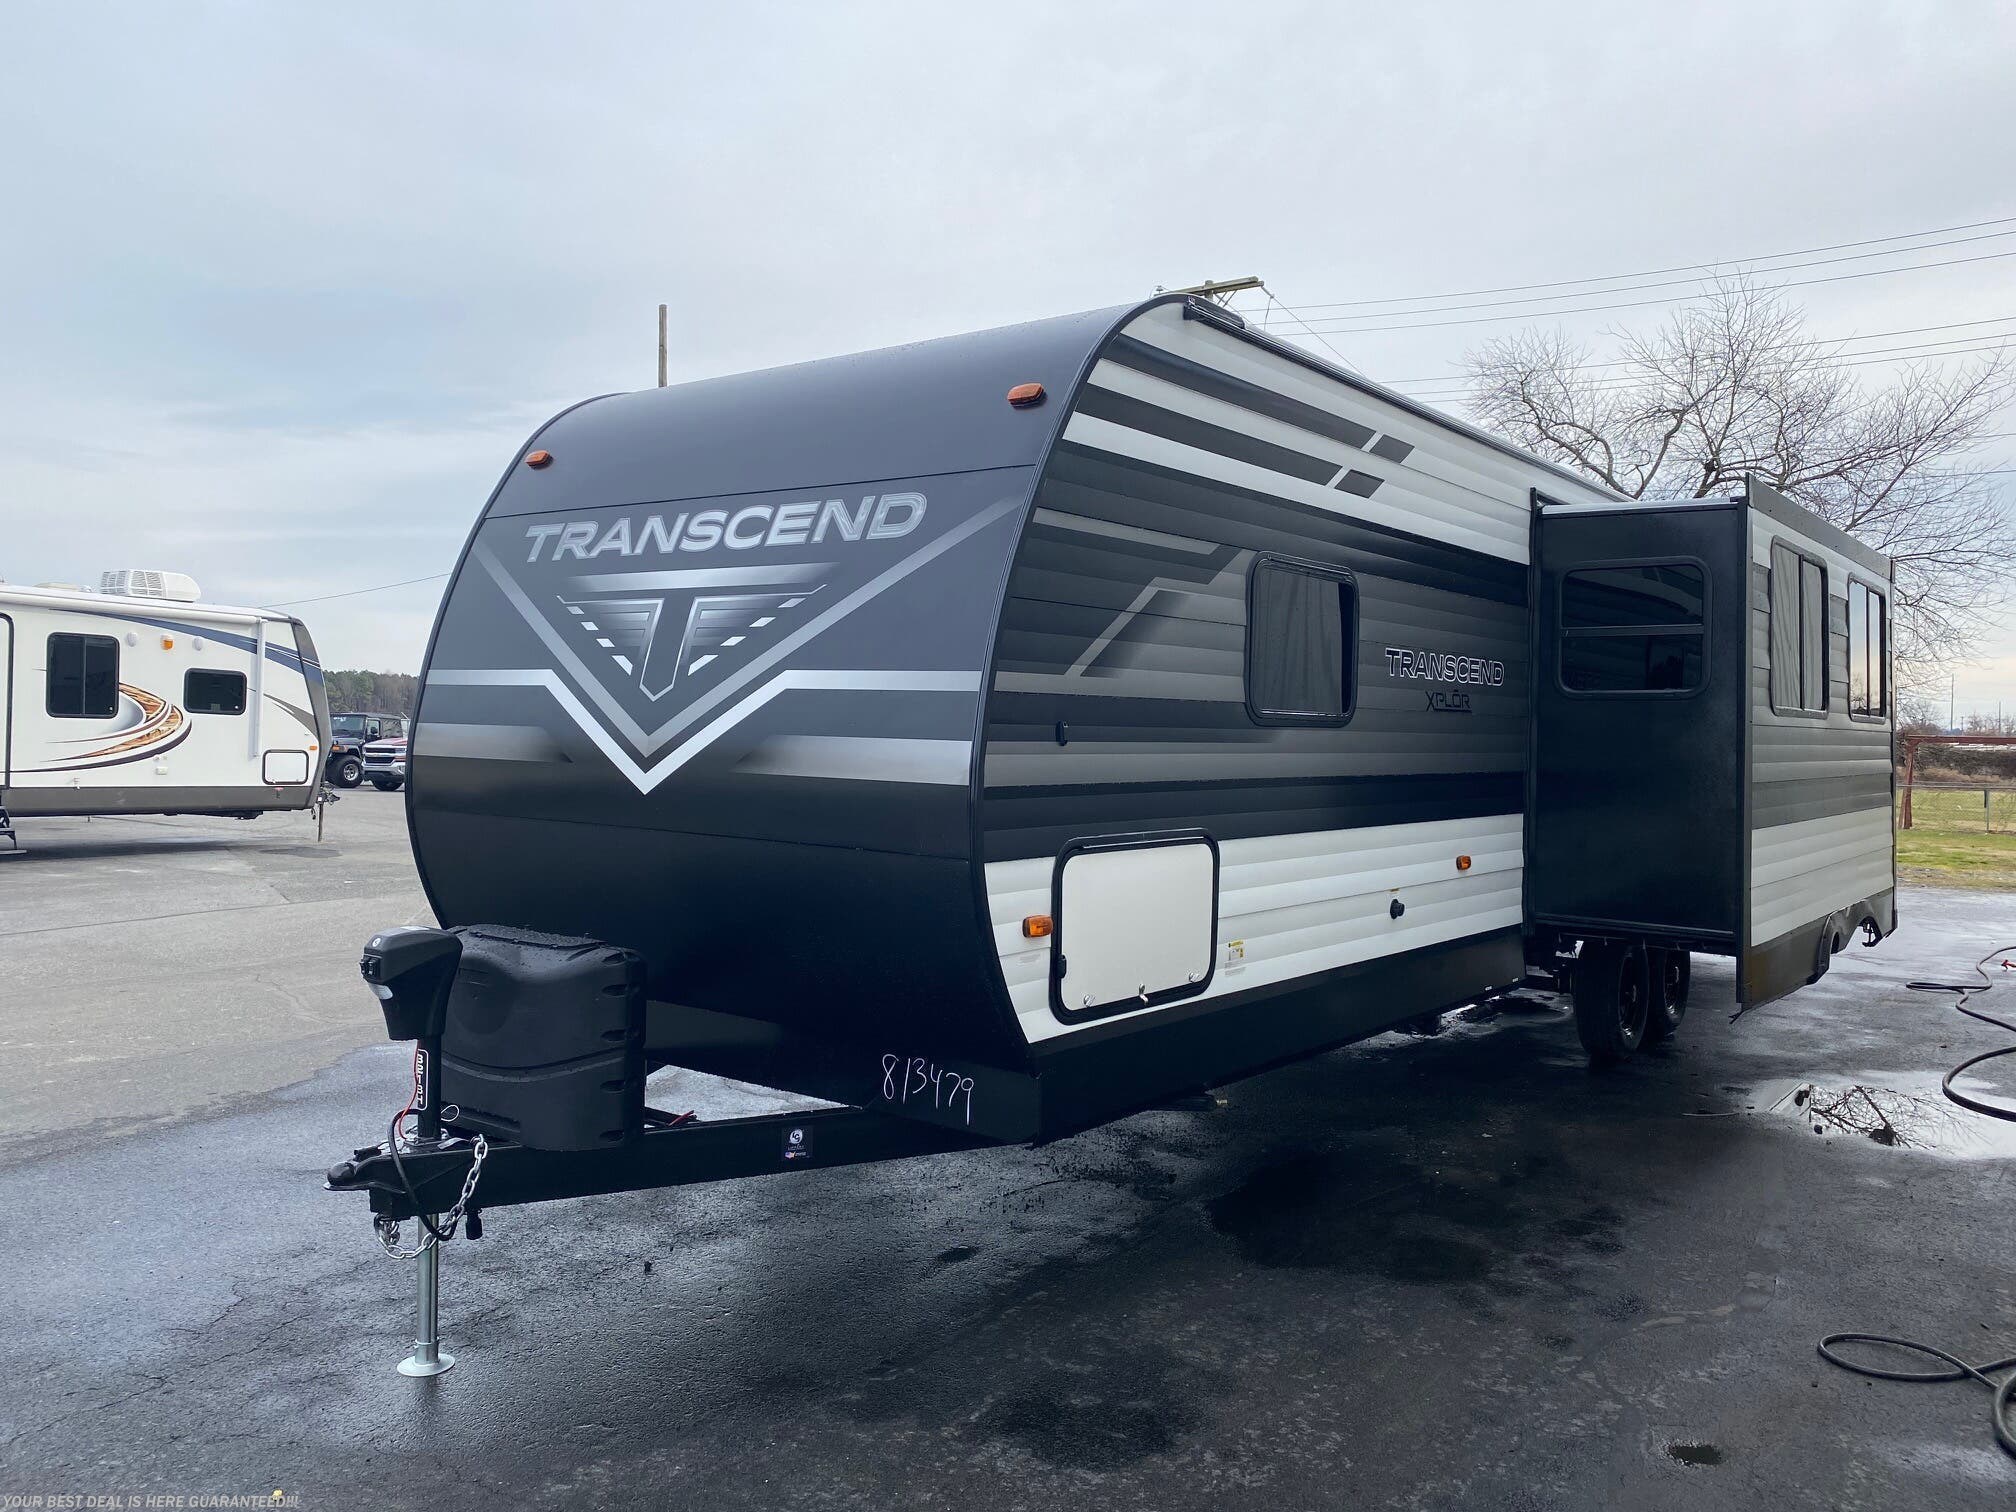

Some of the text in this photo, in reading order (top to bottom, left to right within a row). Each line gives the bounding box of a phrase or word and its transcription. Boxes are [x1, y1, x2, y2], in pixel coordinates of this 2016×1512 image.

[523, 491, 928, 563] TRANSCEND
[1385, 647, 1505, 687] TRANSCEND
[882, 1053, 975, 1126] 813479
